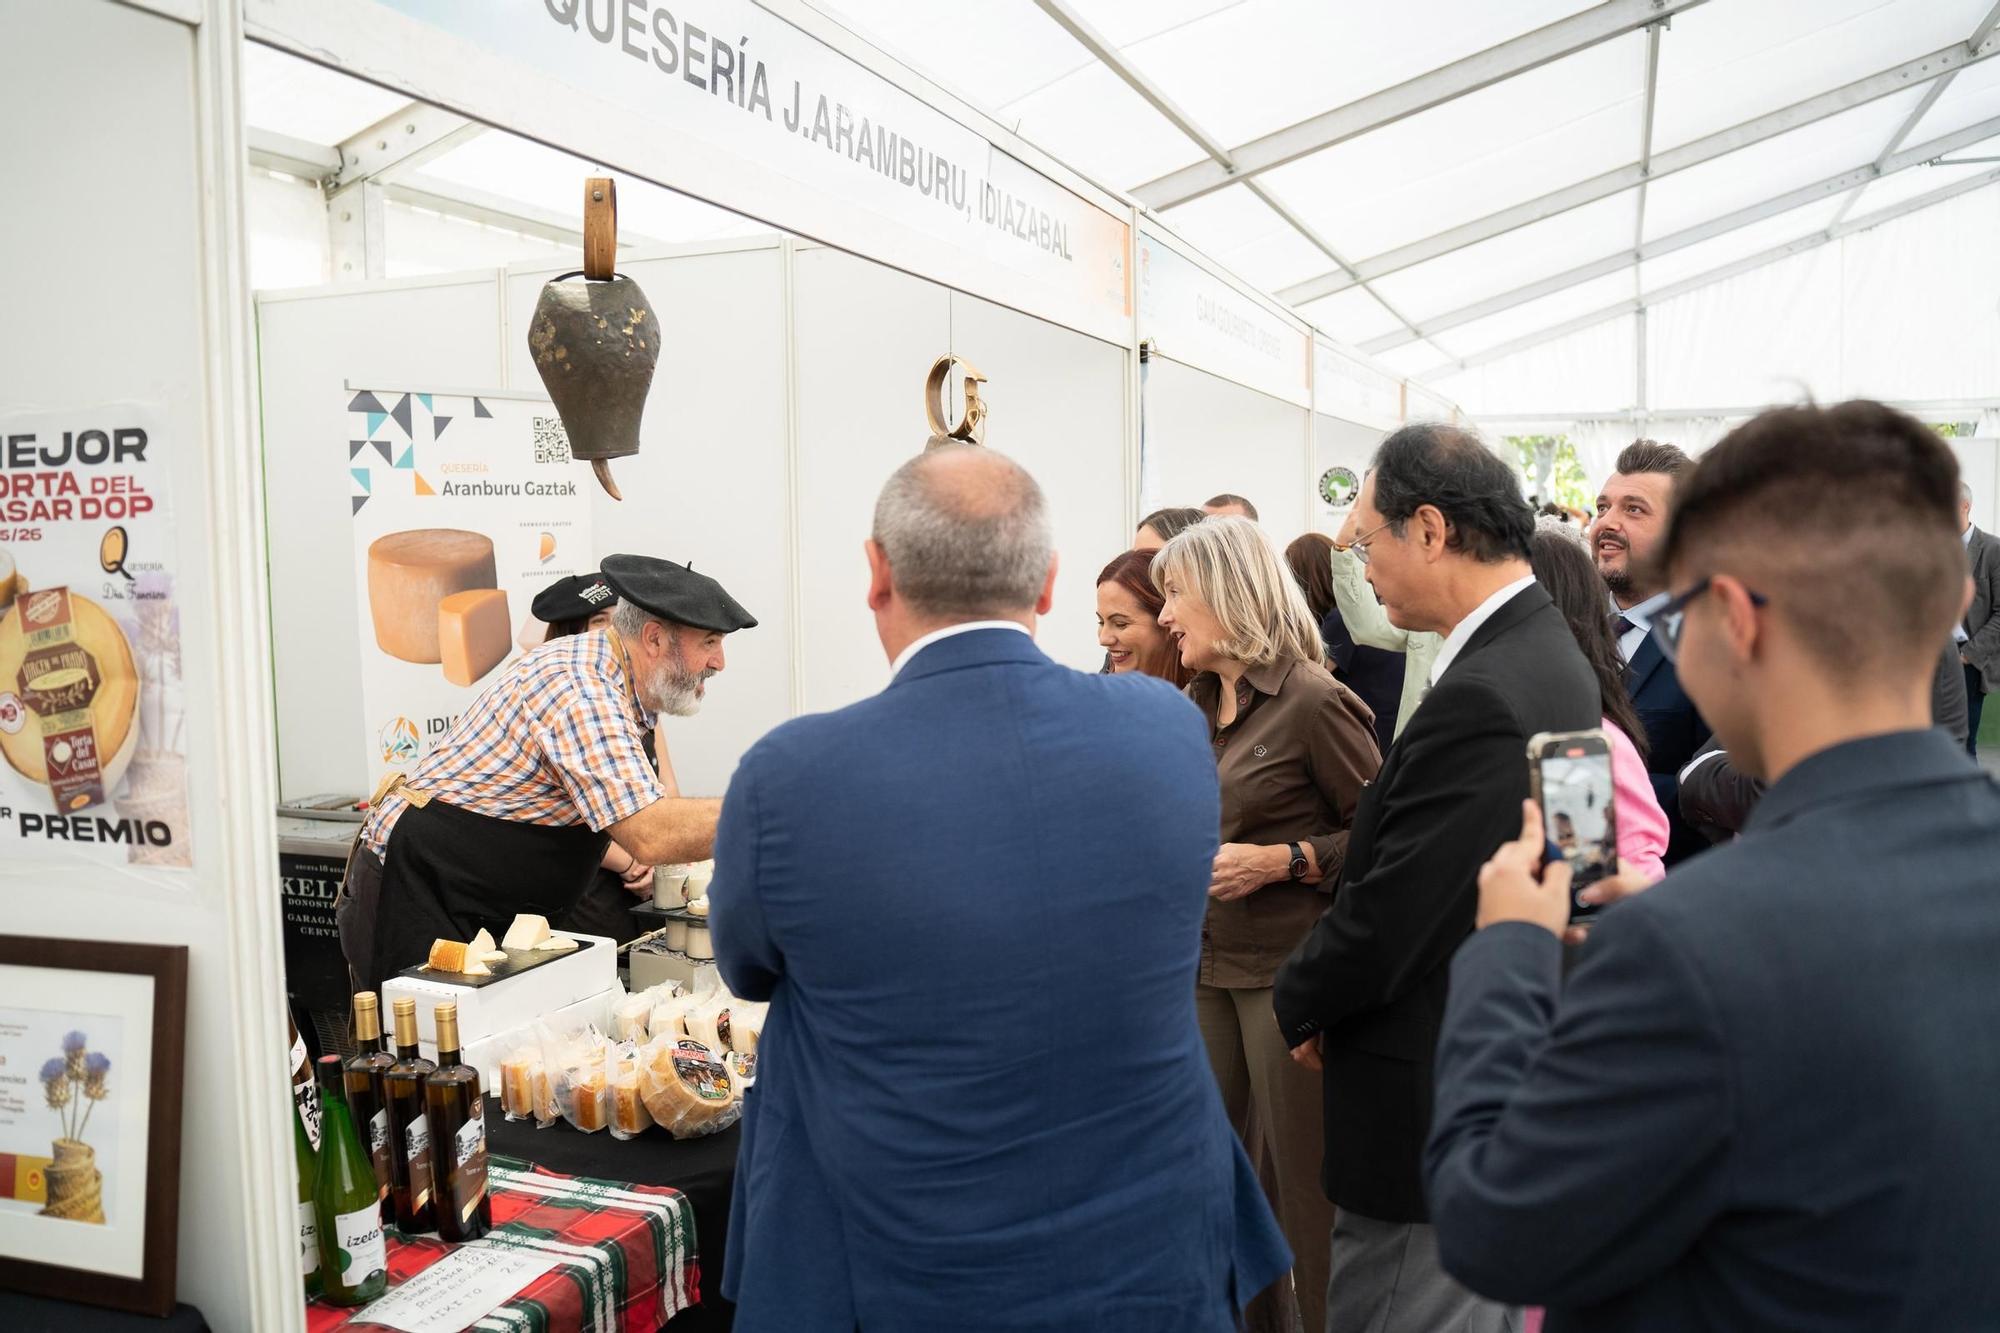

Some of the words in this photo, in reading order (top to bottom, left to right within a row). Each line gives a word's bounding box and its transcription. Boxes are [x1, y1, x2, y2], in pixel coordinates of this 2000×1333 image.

[978, 178, 1073, 262] IDIAZABAL
[0, 427, 148, 470] EJOR
[440, 463, 489, 474] QUESERÍA
[91, 475, 145, 495] DEL
[442, 480, 521, 496] Aranburu
[524, 481, 577, 496] Gaztak
[80, 495, 154, 520] DOP
[588, 588, 613, 605] FEST
[70, 735, 93, 749] Torta
[76, 746, 90, 758] del
[72, 757, 98, 773] Casar
[19, 812, 172, 847] PREMIO
